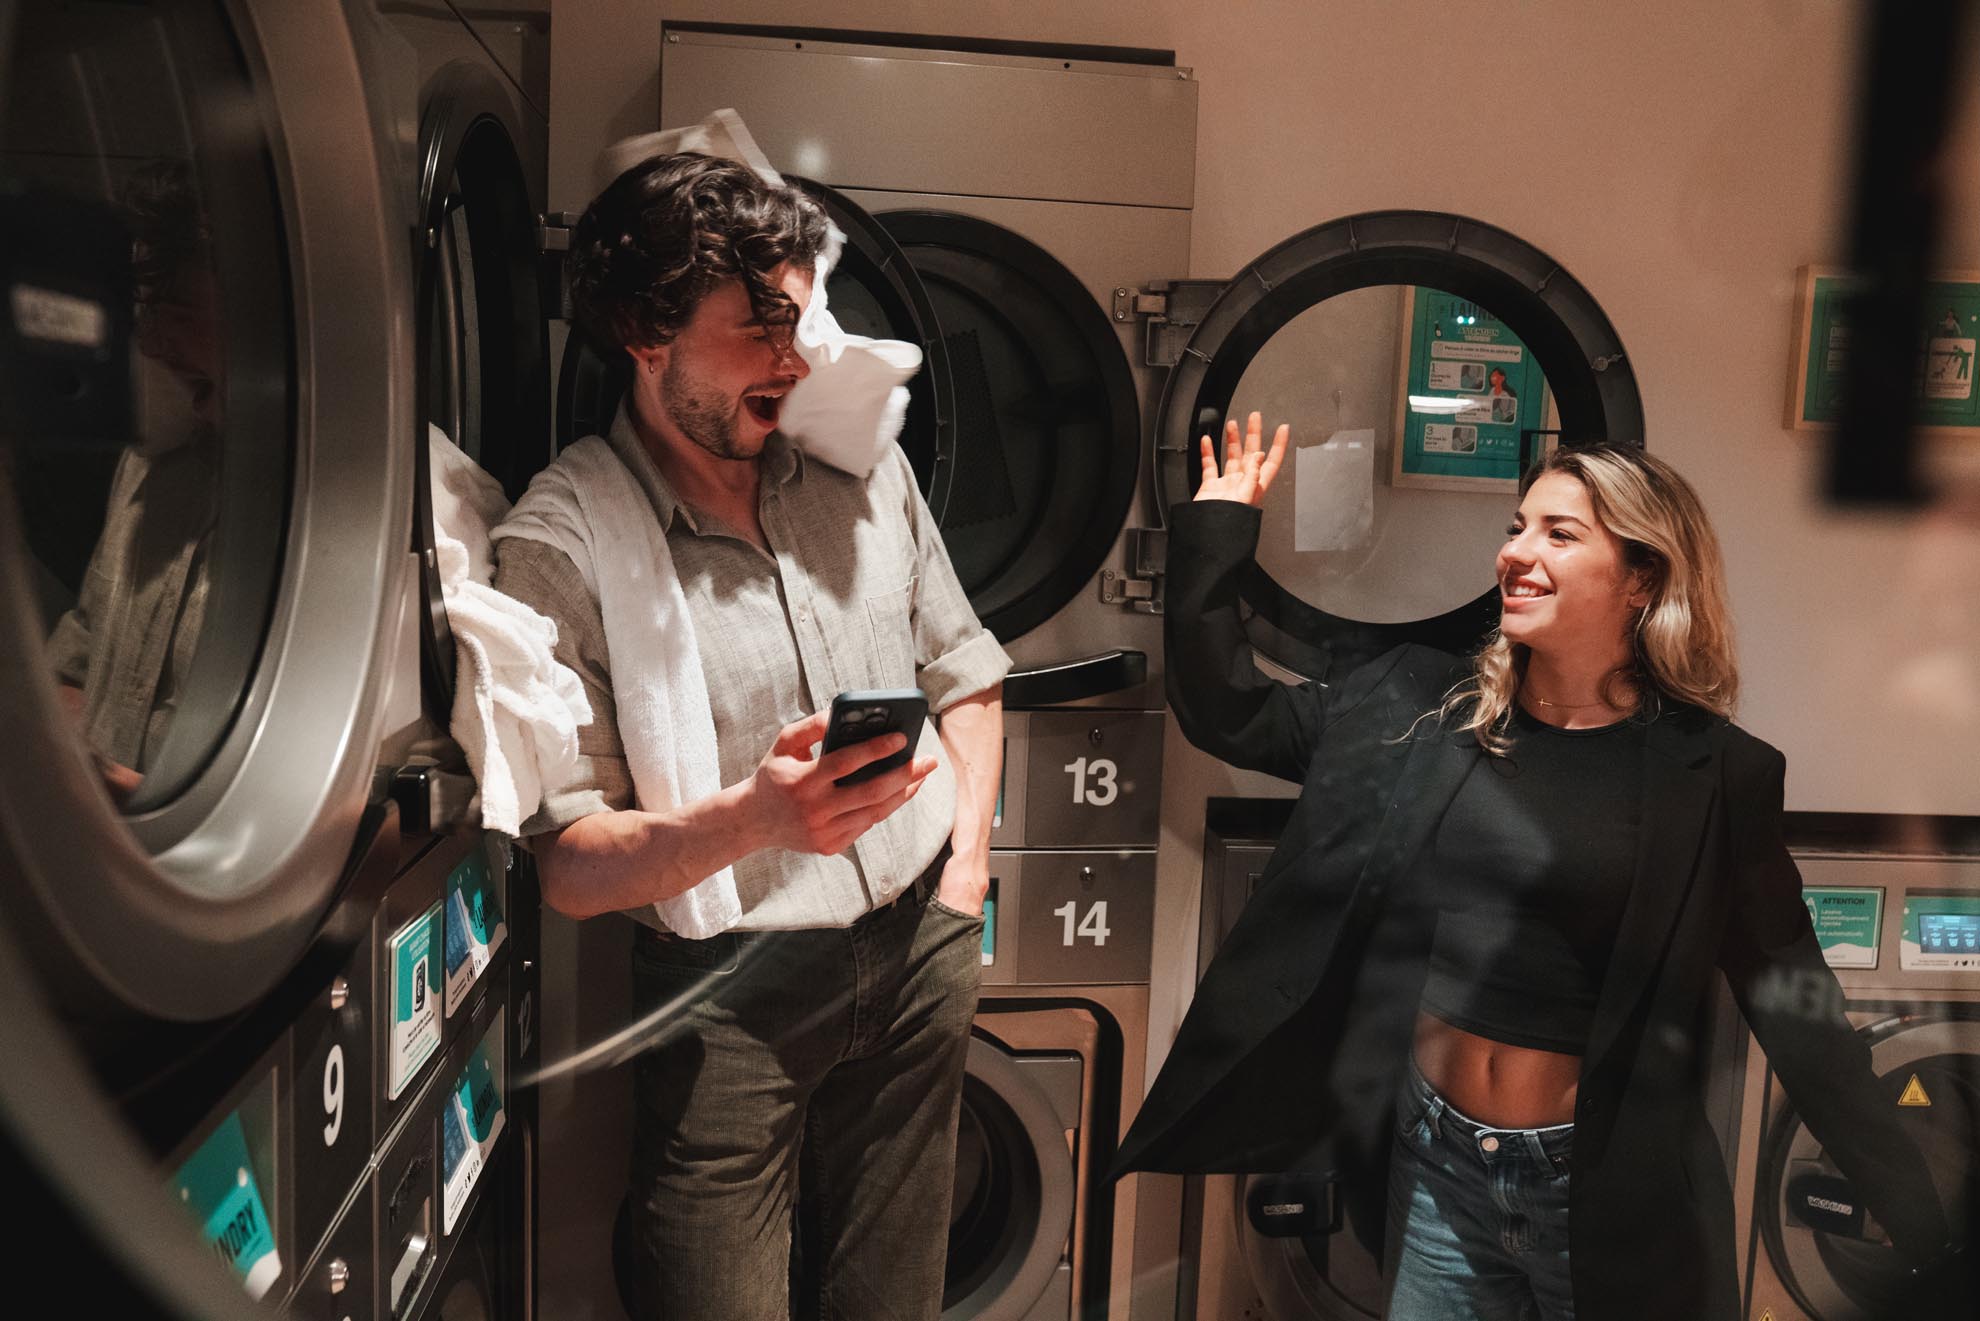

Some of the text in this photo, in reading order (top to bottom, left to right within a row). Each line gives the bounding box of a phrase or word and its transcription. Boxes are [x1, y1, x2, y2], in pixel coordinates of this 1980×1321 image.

[1426, 425, 1434, 436] 3
[1064, 757, 1118, 806] 13
[1054, 901, 1110, 946] 14
[517, 989, 533, 1058] 12
[323, 1044, 344, 1147] 9
